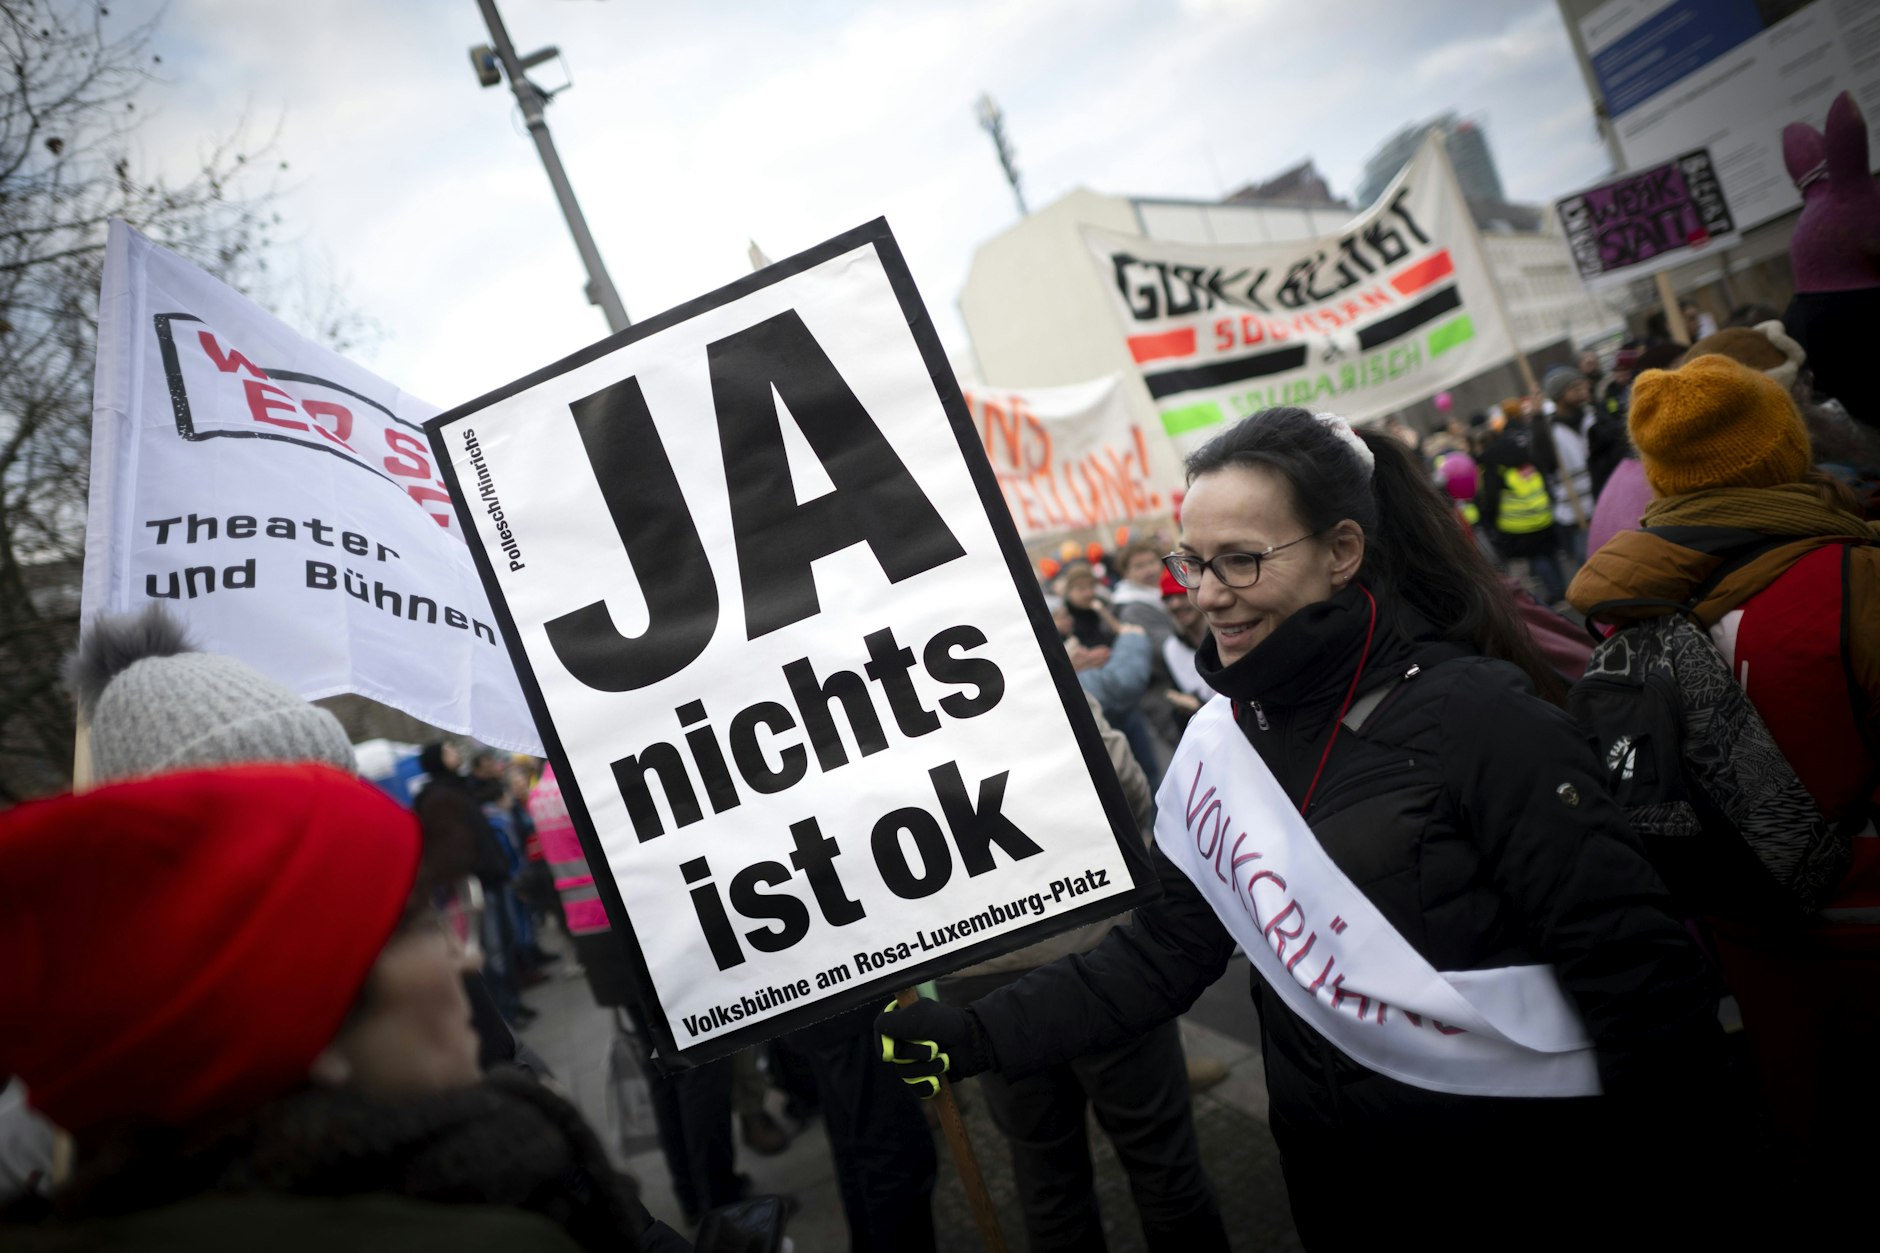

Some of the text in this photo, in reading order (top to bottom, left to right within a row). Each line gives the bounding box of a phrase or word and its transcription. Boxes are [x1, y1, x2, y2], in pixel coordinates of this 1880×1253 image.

[463, 428, 526, 573] Pollesch/Hinrichs
[543, 308, 967, 693] JA
[964, 389, 1053, 478] NS
[146, 513, 400, 561] Theater
[146, 559, 497, 646] und Bühnen
[609, 623, 1006, 844] nichts
[679, 759, 1045, 972] ist ok
[682, 866, 1111, 1039] Volksbühne am Rosa-Luxemburg-Platz
